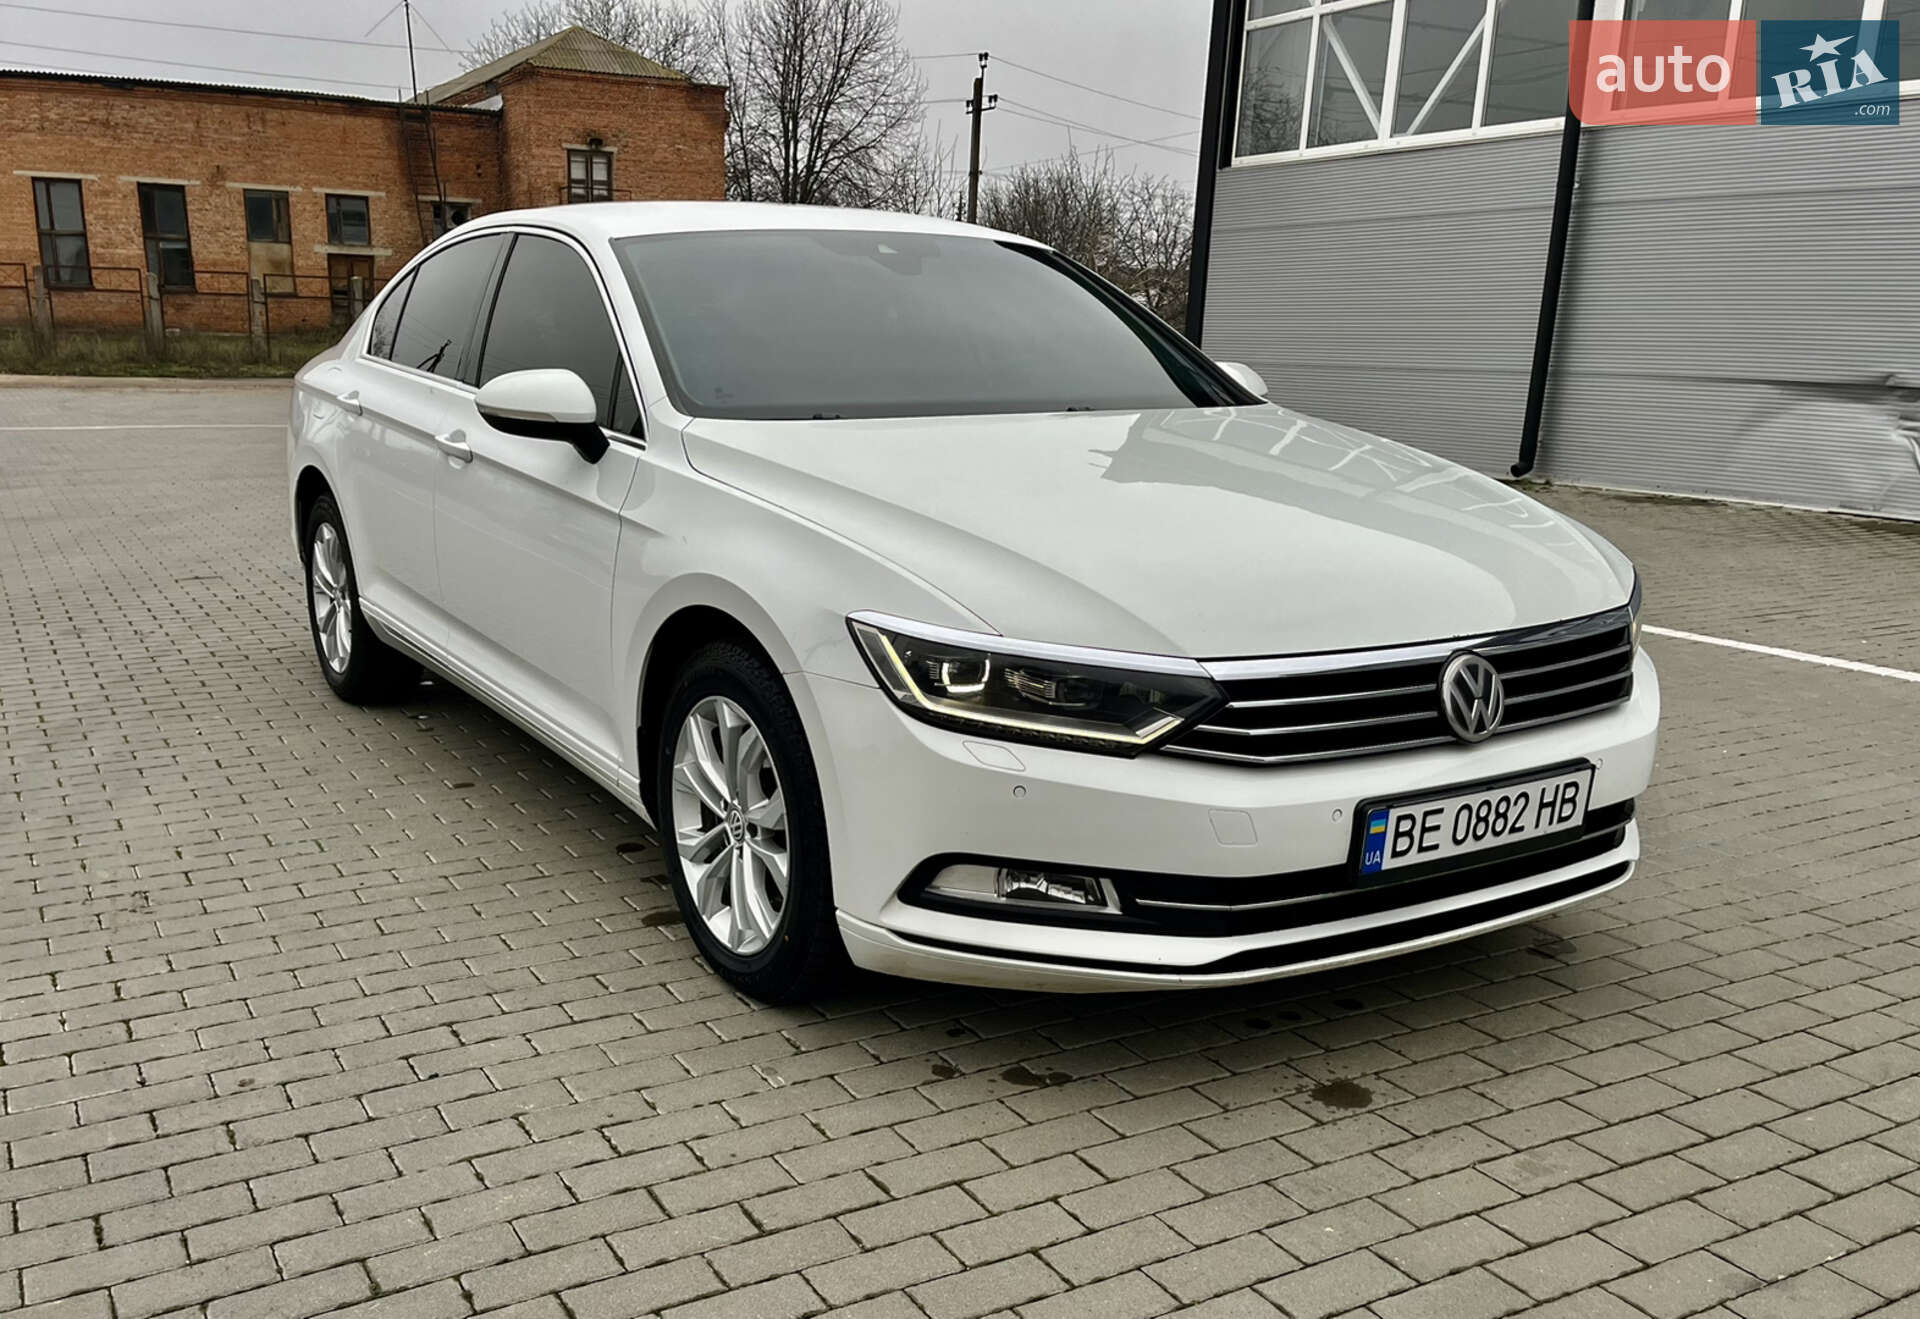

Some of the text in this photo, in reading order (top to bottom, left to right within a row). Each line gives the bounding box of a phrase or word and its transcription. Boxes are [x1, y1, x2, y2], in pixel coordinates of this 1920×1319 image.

[1390, 780, 1580, 860] BE 0882 HB
[1364, 853, 1382, 866] UA
